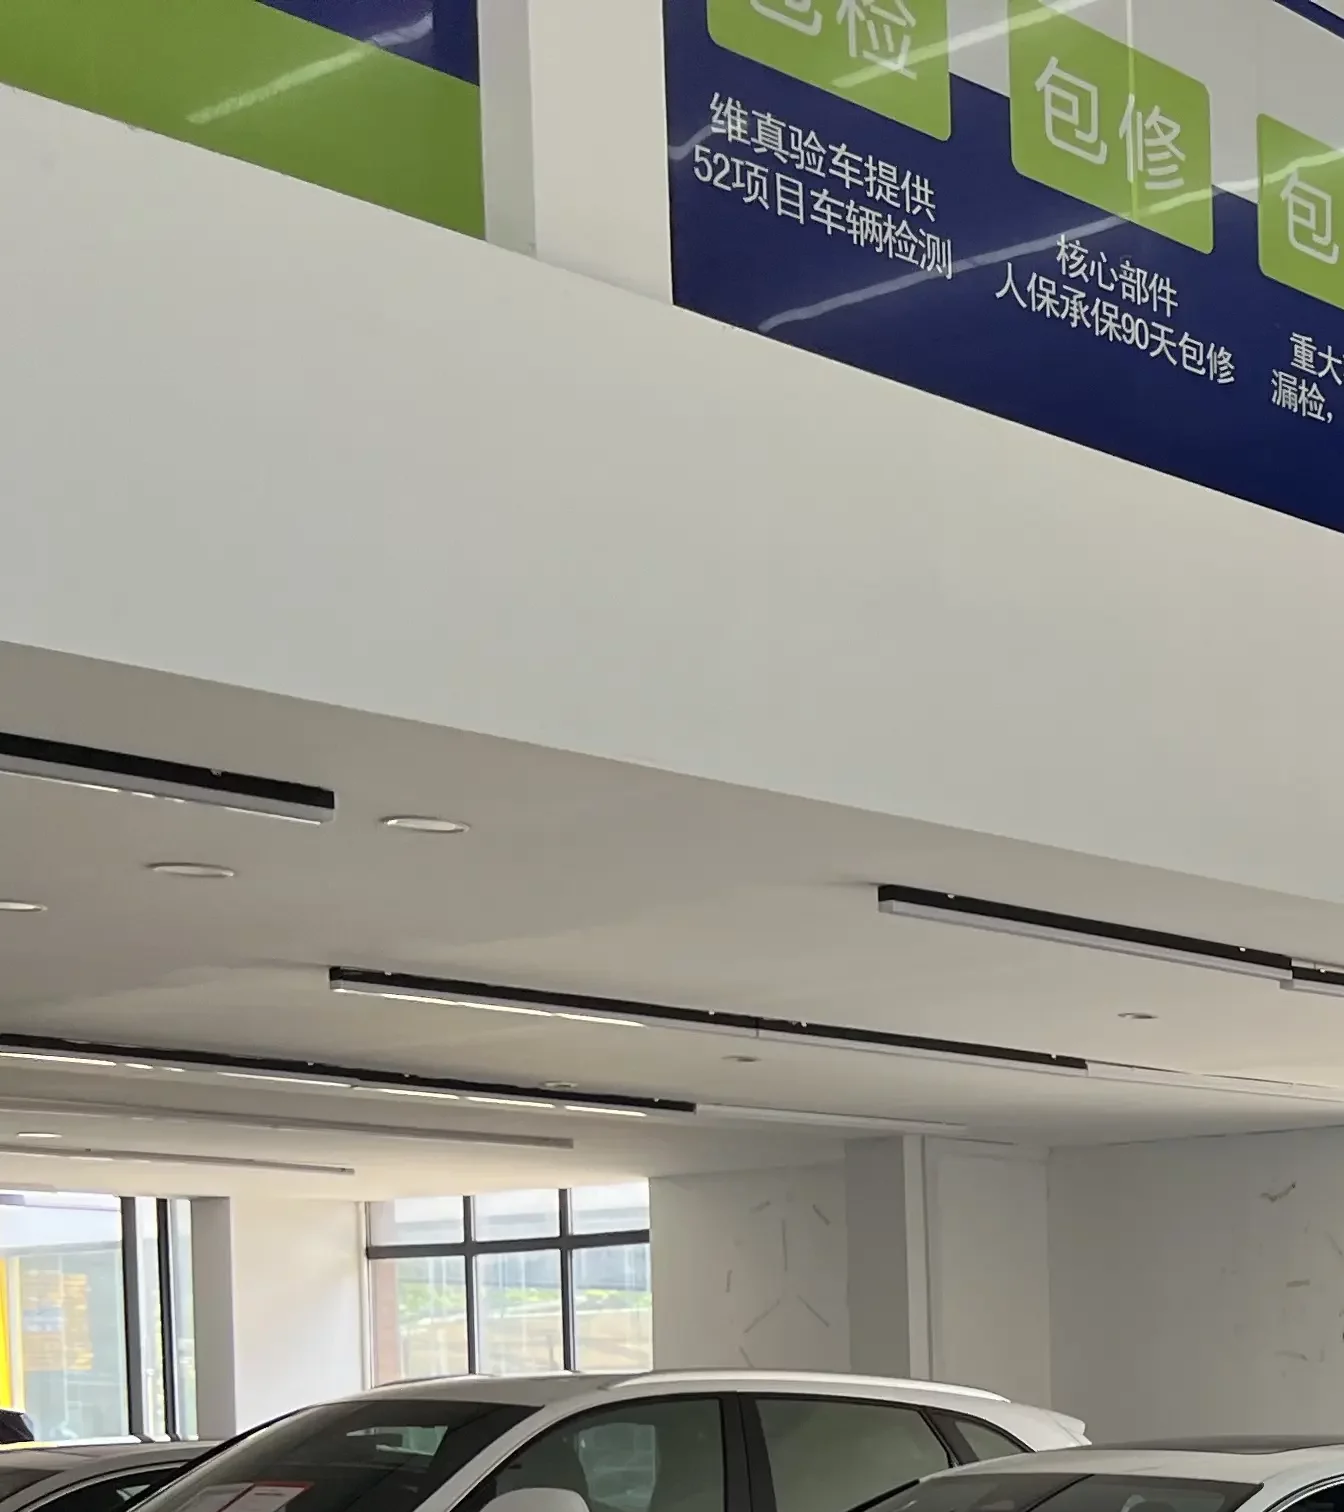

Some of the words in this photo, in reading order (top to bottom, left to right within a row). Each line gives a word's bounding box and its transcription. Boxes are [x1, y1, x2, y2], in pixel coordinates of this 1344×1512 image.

[709, 92, 937, 222] 维真验车提供
[1034, 56, 1187, 193] 包修
[693, 144, 953, 280] 52项目车辆检测
[1056, 234, 1179, 318] 核心部件
[995, 262, 1236, 384] 人保承保90天包修
